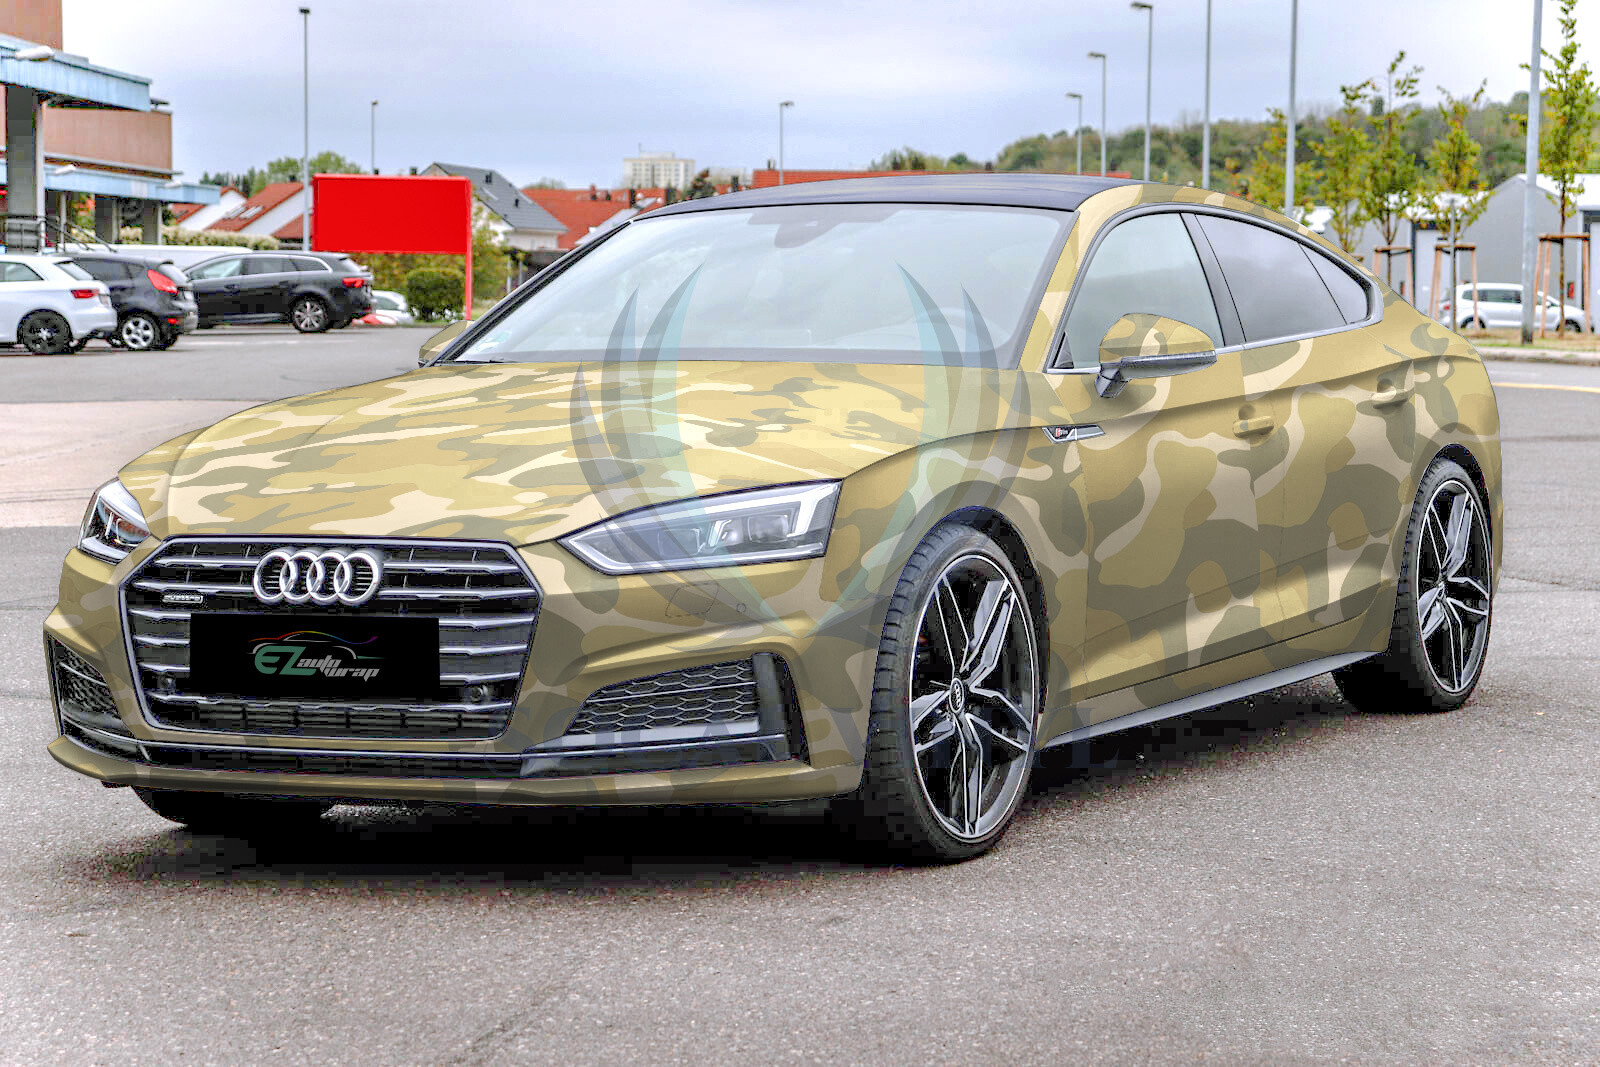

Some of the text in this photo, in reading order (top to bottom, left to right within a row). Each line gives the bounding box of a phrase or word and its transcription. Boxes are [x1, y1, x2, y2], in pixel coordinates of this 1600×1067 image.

[254, 645, 342, 676] EZ auto
[324, 667, 380, 681] wrap
